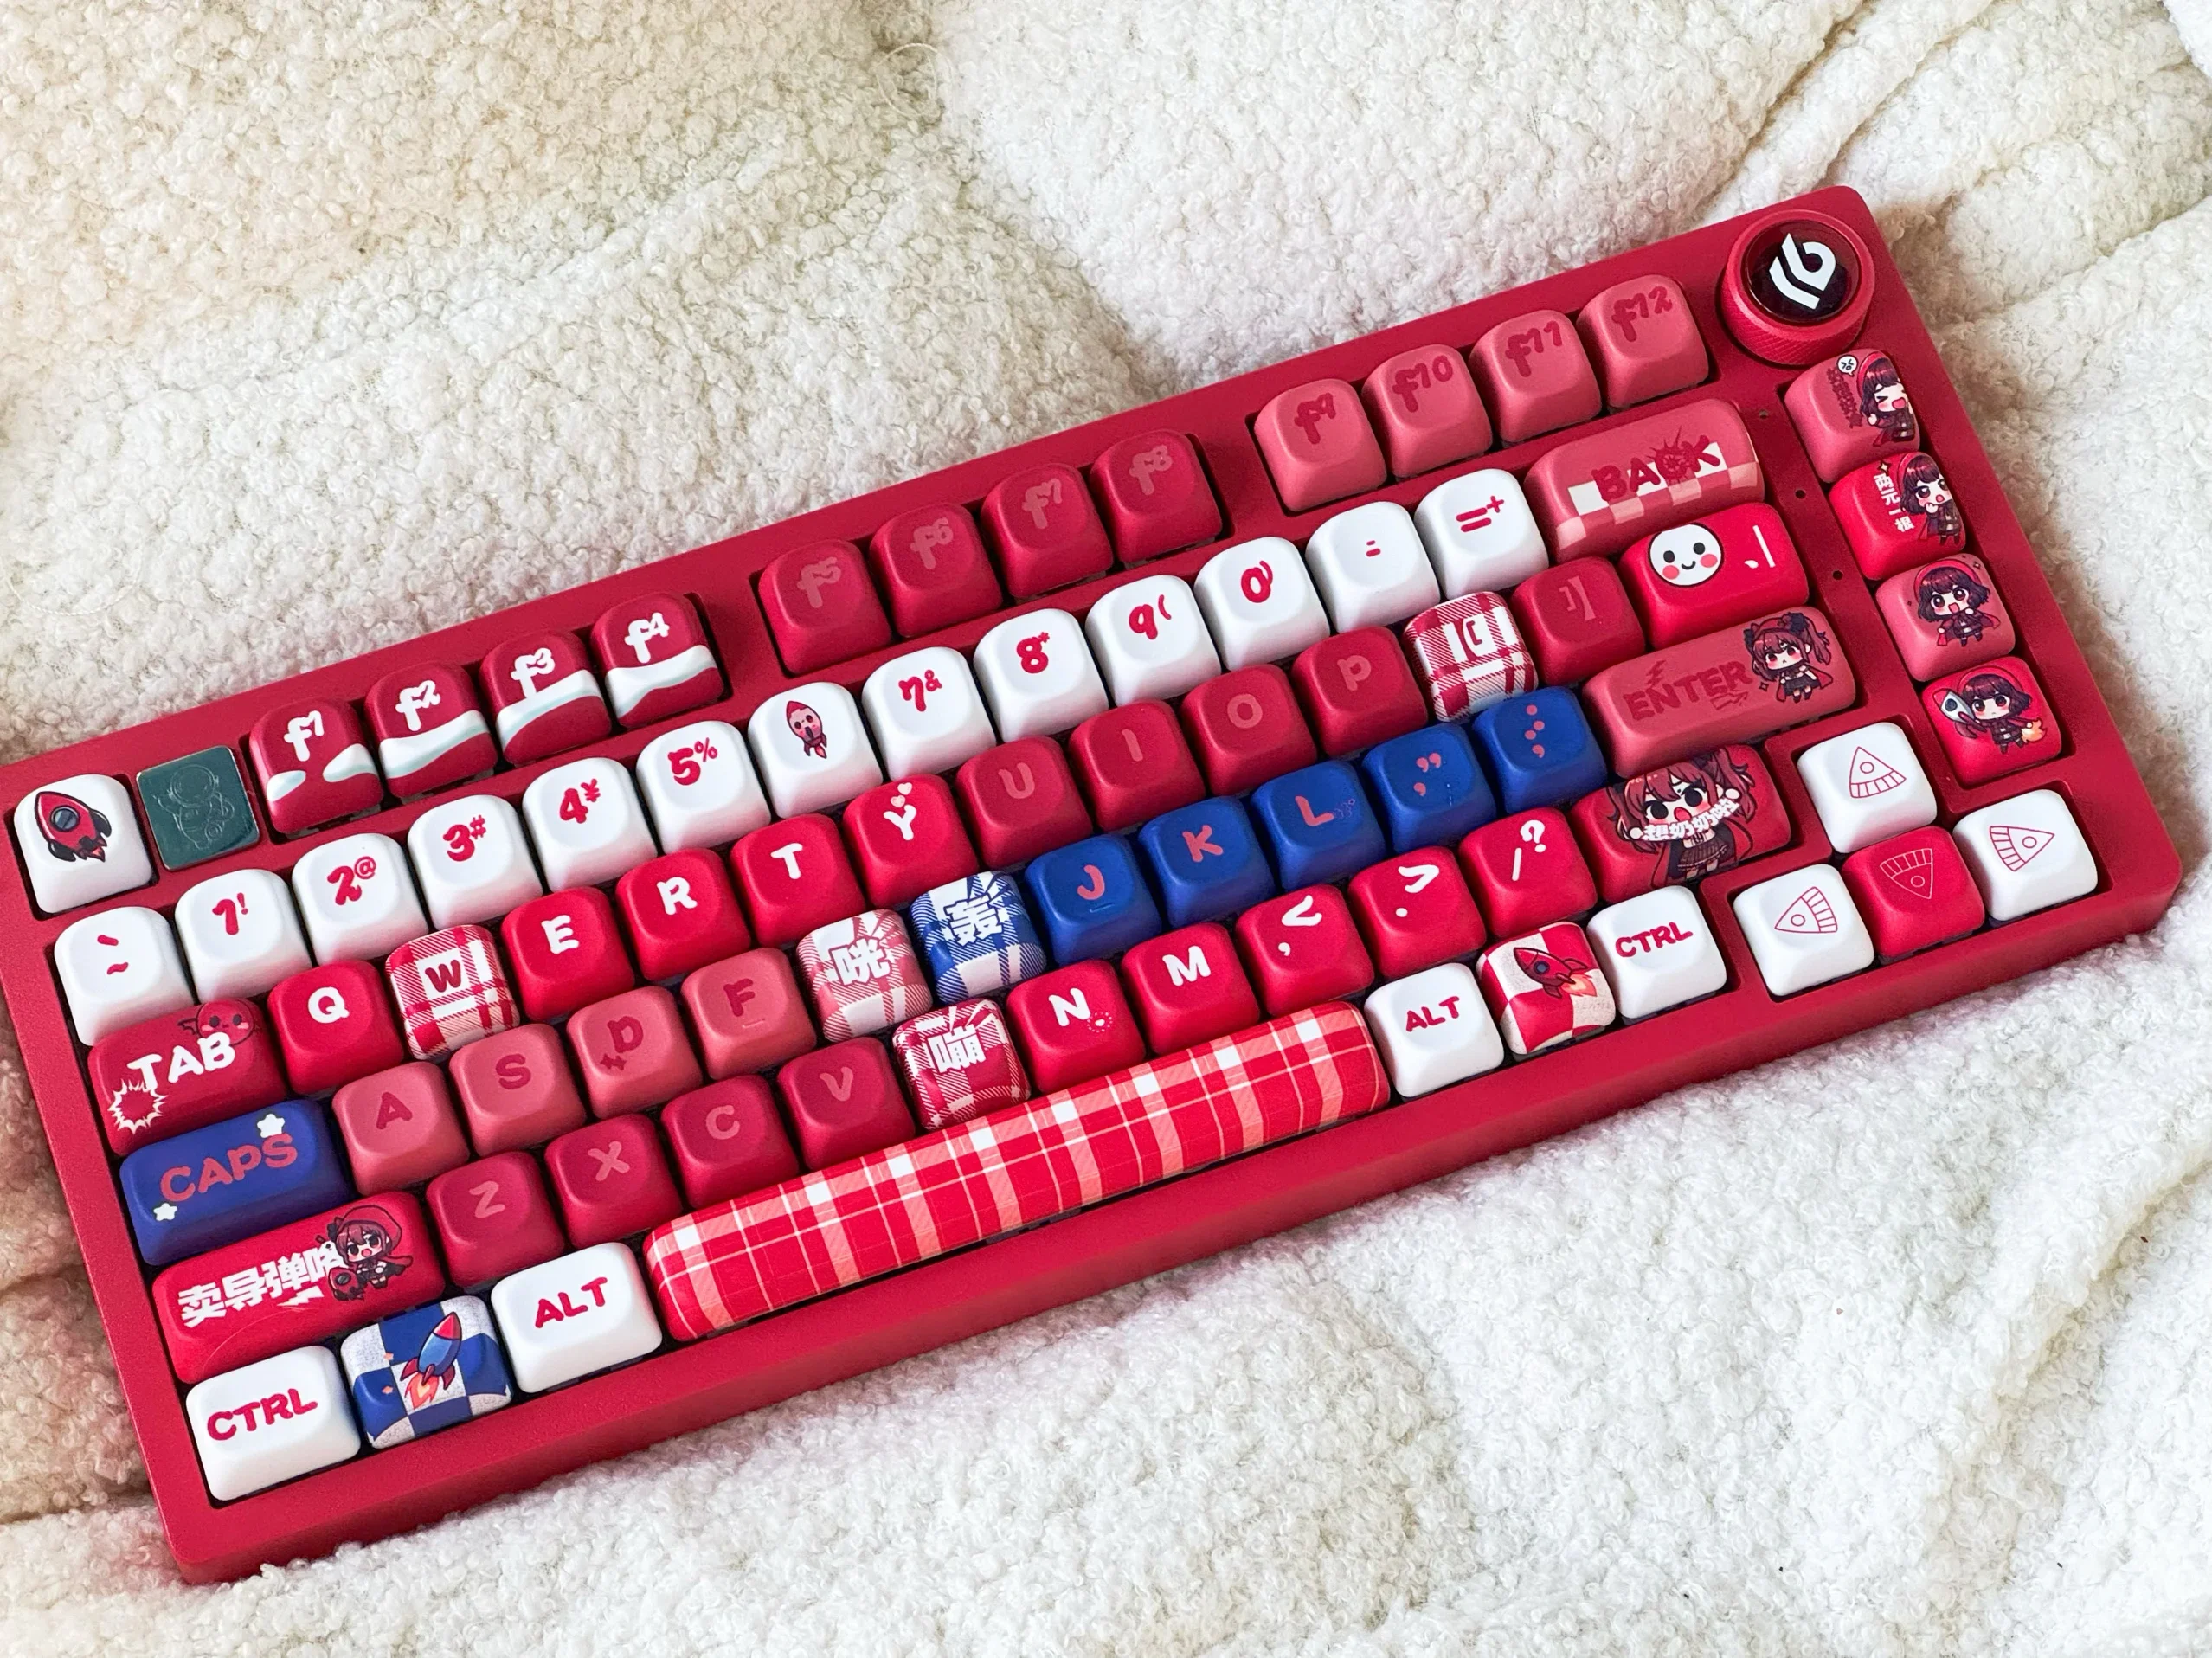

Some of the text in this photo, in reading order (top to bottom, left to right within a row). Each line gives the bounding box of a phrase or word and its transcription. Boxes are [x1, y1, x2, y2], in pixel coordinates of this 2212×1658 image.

[898, 670, 942, 712] 7&
[1623, 660, 1753, 721] ENTER
[1226, 693, 1264, 729] O
[667, 738, 718, 786] 5%
[1122, 729, 1142, 761] I
[999, 762, 1035, 799] U
[884, 805, 917, 840] Y
[1295, 795, 1334, 827] L
[442, 814, 487, 862] 3#
[1182, 825, 1223, 862] K
[771, 843, 803, 879] T
[326, 856, 376, 905] 2@
[656, 876, 698, 915] R
[1077, 864, 1105, 900] J
[541, 915, 580, 954] E
[1614, 922, 1694, 958] CTRL
[425, 960, 461, 993] W
[1162, 945, 1211, 986] M
[308, 986, 348, 1024] Q
[723, 978, 755, 1017] F
[1049, 988, 1090, 1027] N
[1404, 995, 1460, 1033] ALT
[608, 1015, 643, 1052] D
[127, 1031, 236, 1089] TAB
[495, 1053, 531, 1089] S
[820, 1066, 853, 1102] V
[376, 1092, 413, 1130] A
[706, 1104, 740, 1140] C
[161, 1134, 298, 1202] CAPS
[588, 1141, 629, 1182] X
[469, 1181, 505, 1218] Z
[533, 1276, 608, 1328] ALT
[207, 1388, 318, 1442] CTRL
